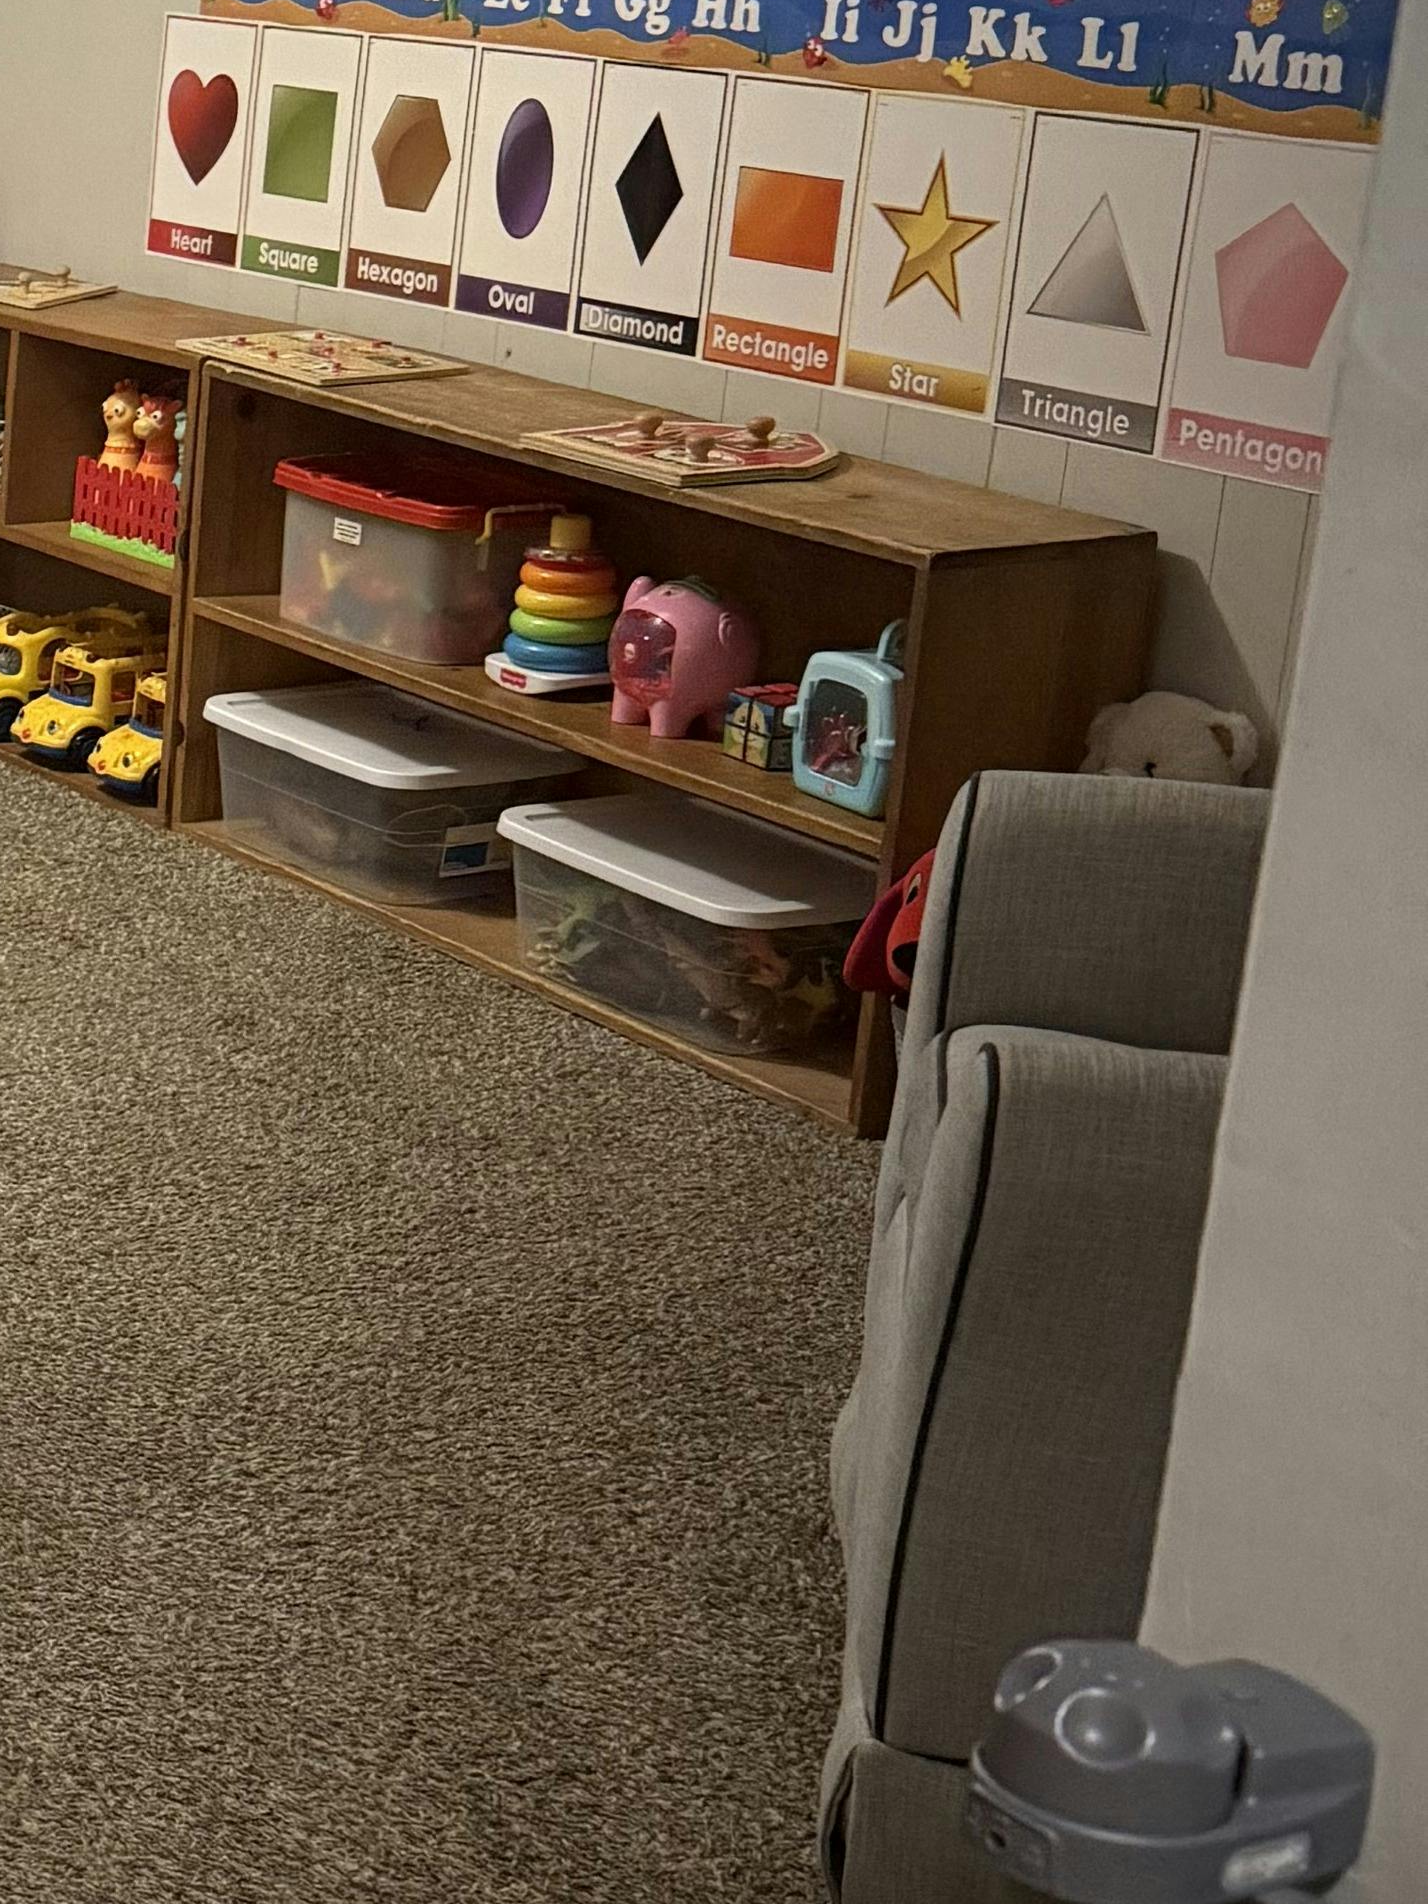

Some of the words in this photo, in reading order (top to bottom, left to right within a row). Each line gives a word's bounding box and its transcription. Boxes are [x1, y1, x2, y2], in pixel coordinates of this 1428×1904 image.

[881, 0, 939, 63] Jj
[965, 5, 1049, 63] Kk
[1076, 15, 1141, 72] Ll
[1227, 30, 1344, 95] Mm
[169, 228, 212, 257] Heart
[257, 241, 319, 276] Square
[356, 255, 439, 295] Hexagon
[487, 283, 535, 316] Oval
[587, 304, 684, 347] Diamond
[711, 322, 829, 372] Rectangle
[888, 362, 939, 398] Star
[1021, 389, 1131, 437] Triangle
[1179, 418, 1323, 475] Pentagon
